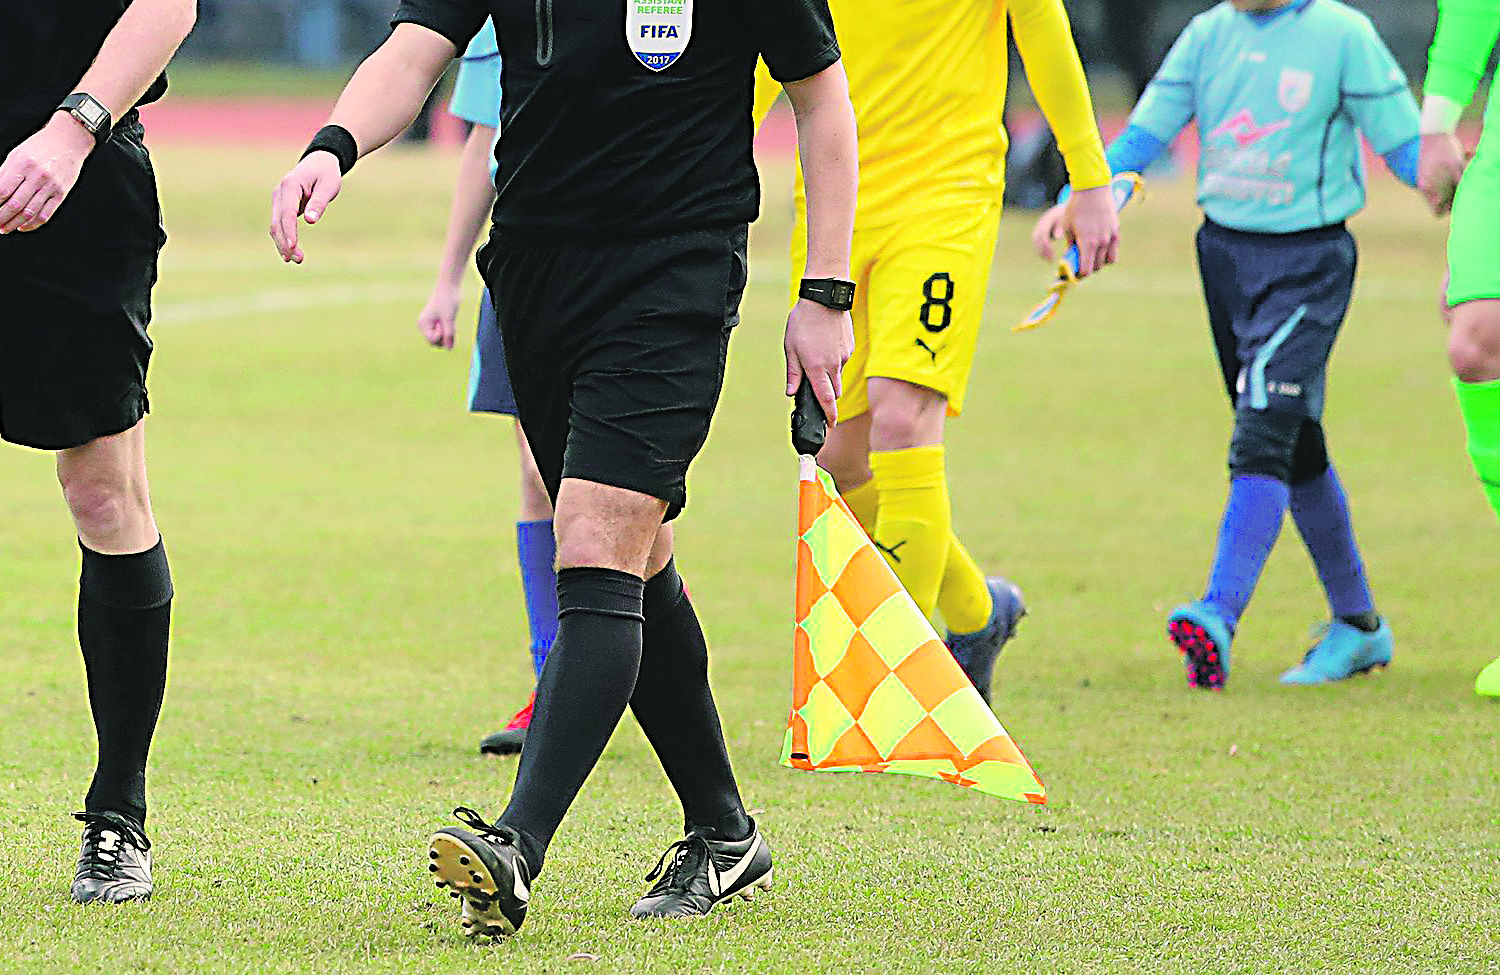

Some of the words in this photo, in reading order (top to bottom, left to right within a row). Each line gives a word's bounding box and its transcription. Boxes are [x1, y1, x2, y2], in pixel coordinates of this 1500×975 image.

[637, 5, 683, 15] REFEREE
[640, 25, 679, 39] FIFA
[646, 55, 670, 65] 2017
[919, 272, 955, 334] 8
